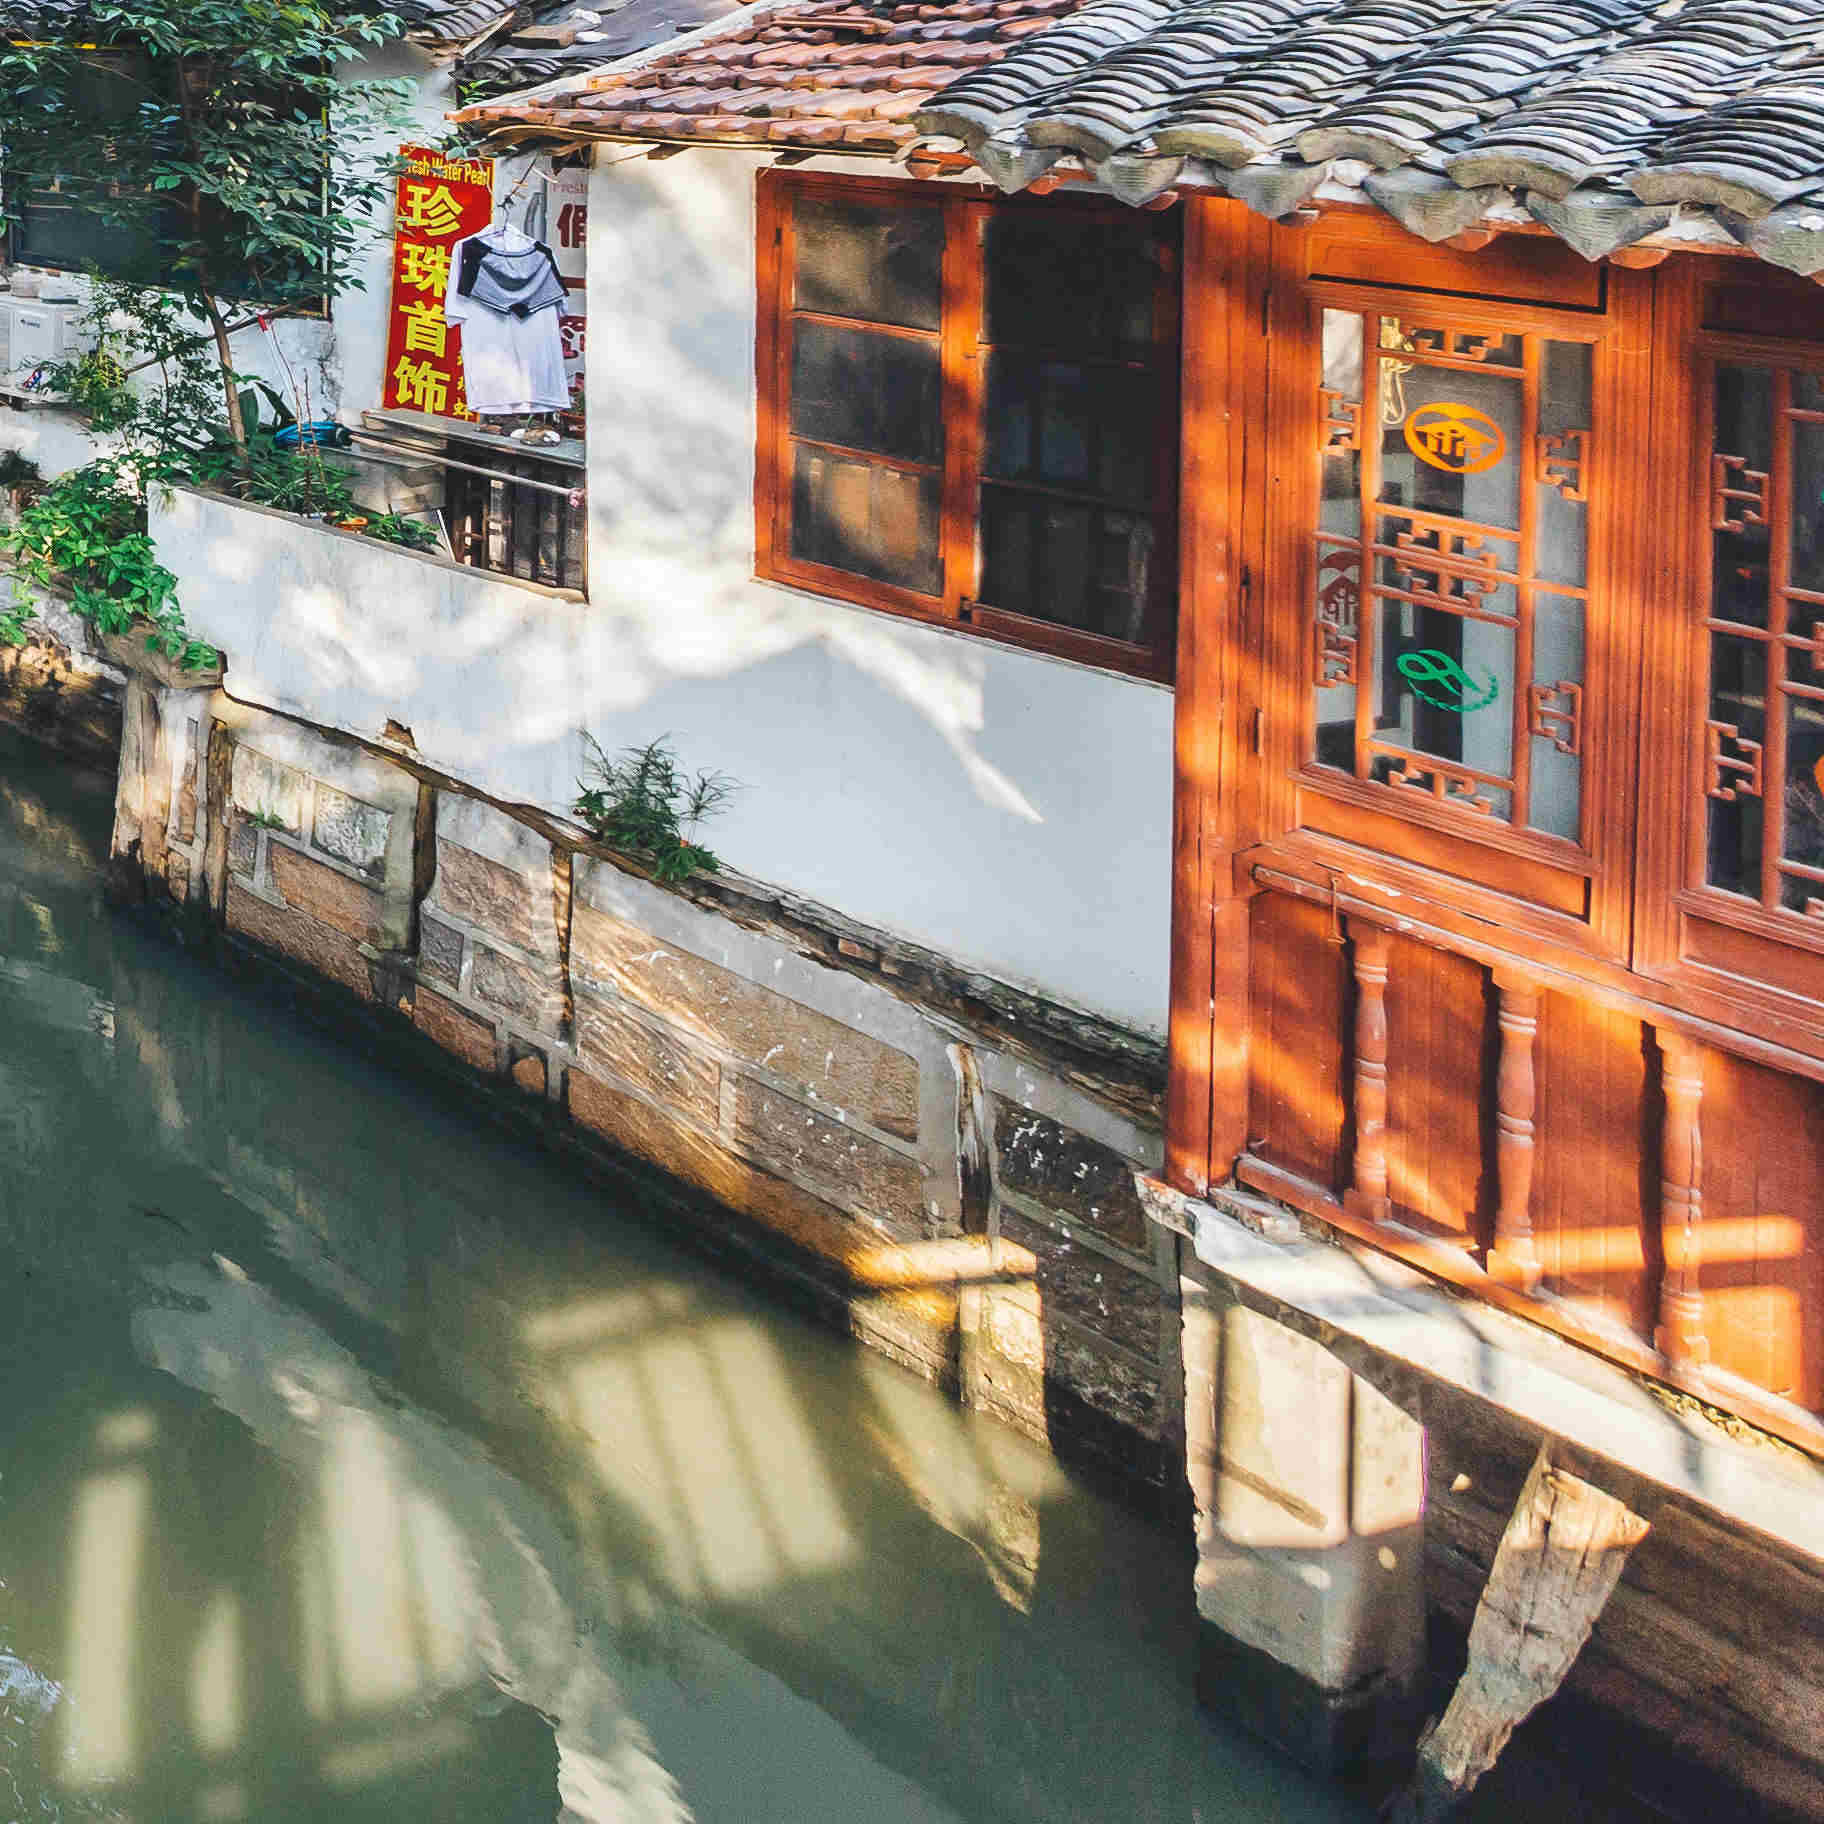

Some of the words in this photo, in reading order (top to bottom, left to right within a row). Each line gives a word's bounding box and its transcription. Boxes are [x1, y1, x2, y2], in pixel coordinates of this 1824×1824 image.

[464, 162, 491, 186] Pearl
[393, 184, 464, 415] 珍珠首饰
